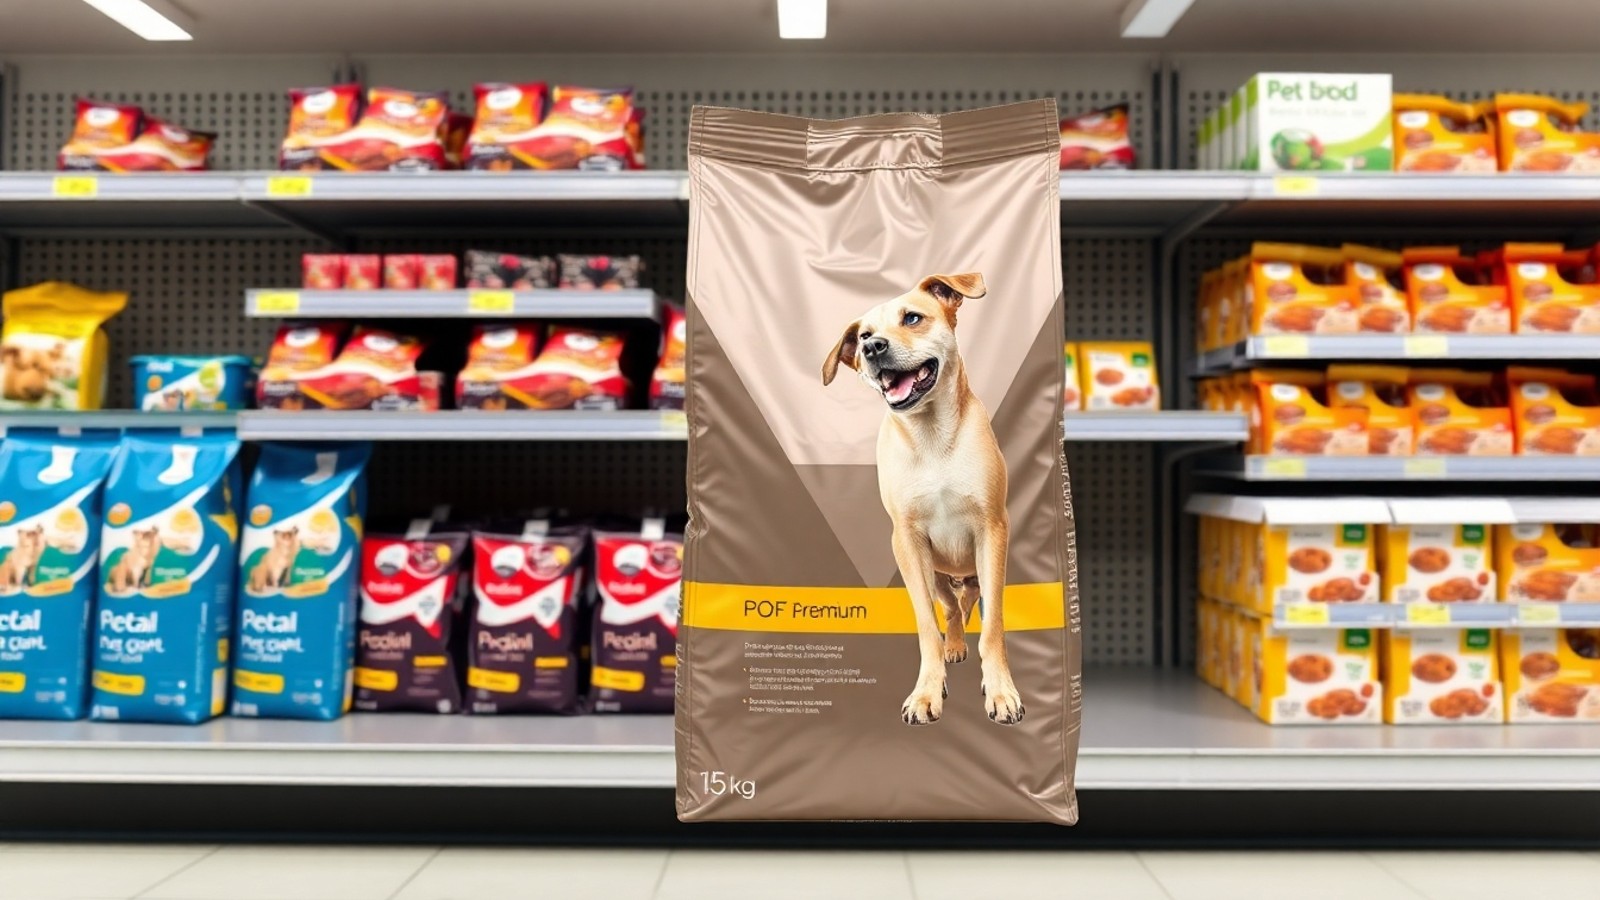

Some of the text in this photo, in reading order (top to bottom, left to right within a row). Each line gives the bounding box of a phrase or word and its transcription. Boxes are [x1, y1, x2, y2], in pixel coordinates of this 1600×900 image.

[1267, 80, 1303, 101] Pet
[0, 609, 42, 631] etal
[743, 600, 867, 619] POF Premium
